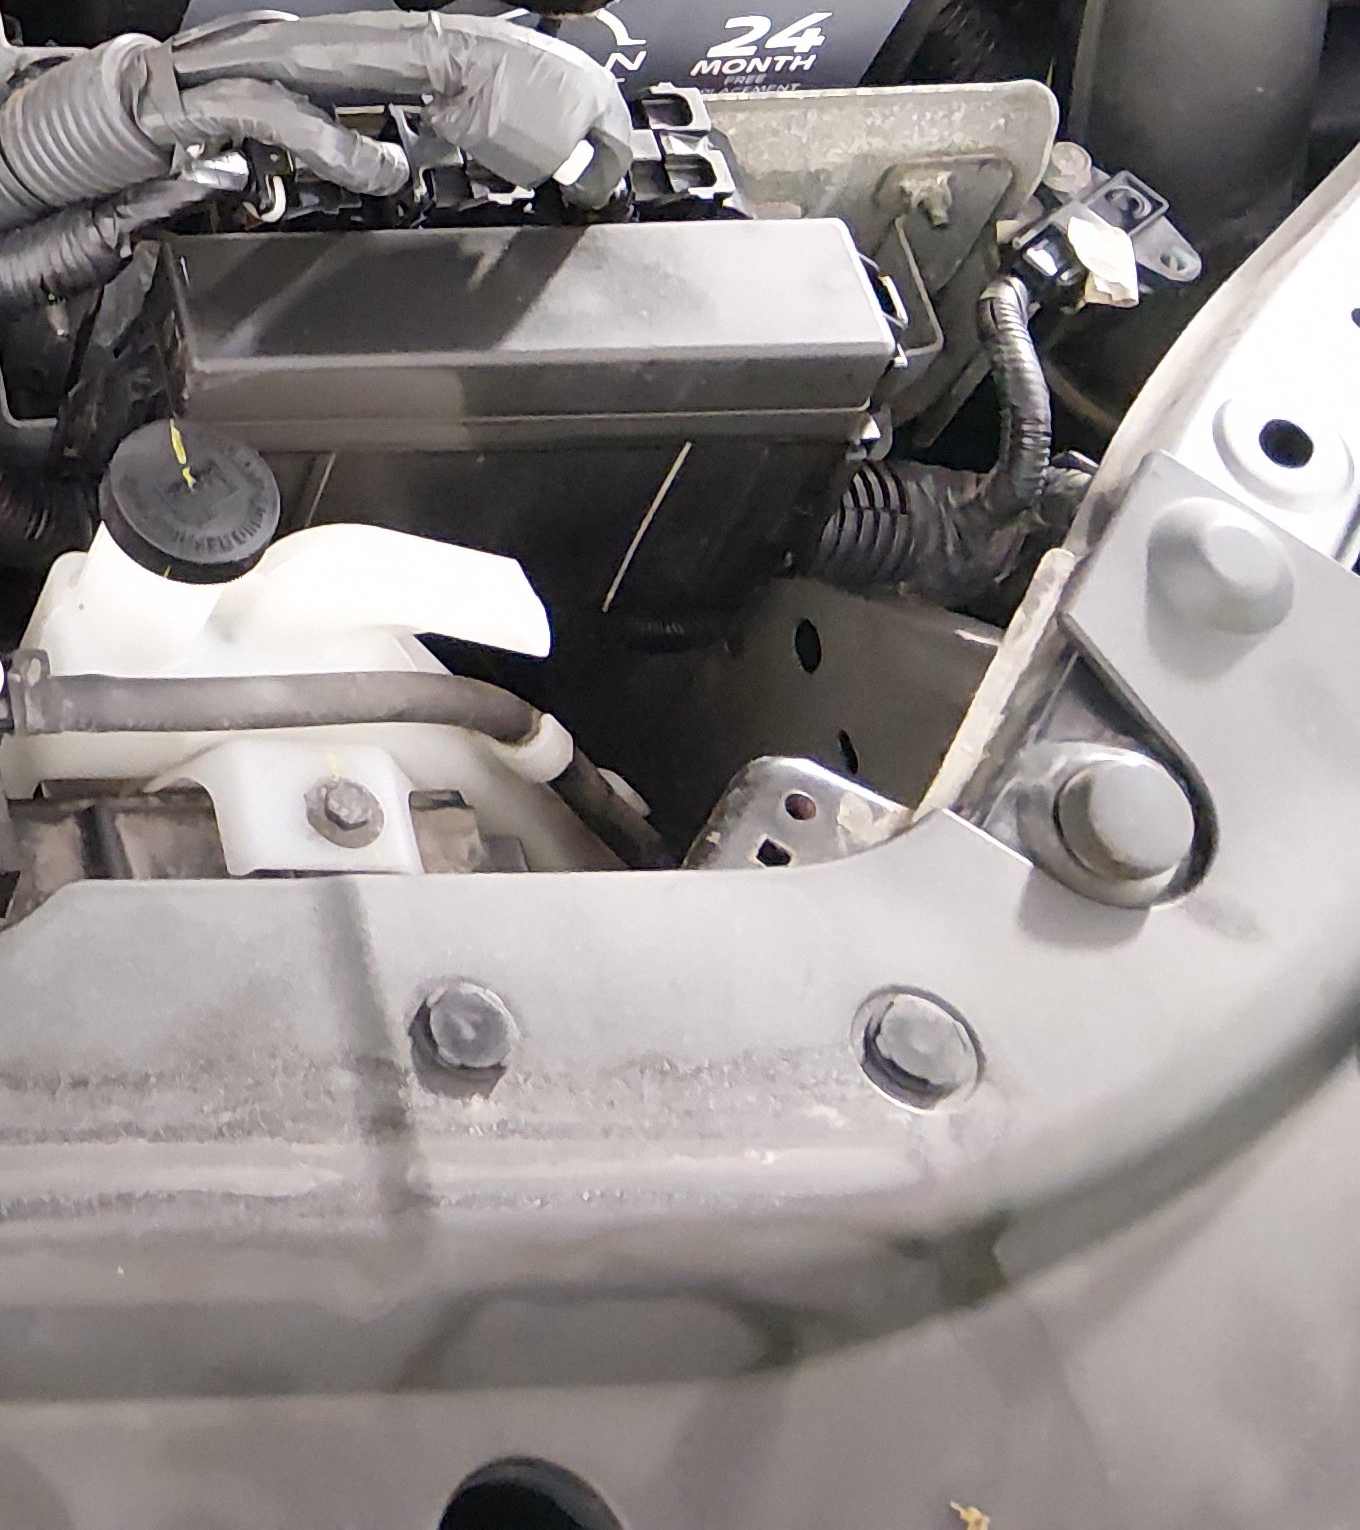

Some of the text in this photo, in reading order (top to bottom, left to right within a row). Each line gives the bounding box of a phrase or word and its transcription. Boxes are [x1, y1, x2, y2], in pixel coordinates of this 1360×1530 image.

[707, 12, 833, 58] 24
[690, 54, 817, 77] MONTH
[724, 74, 767, 84] FREE
